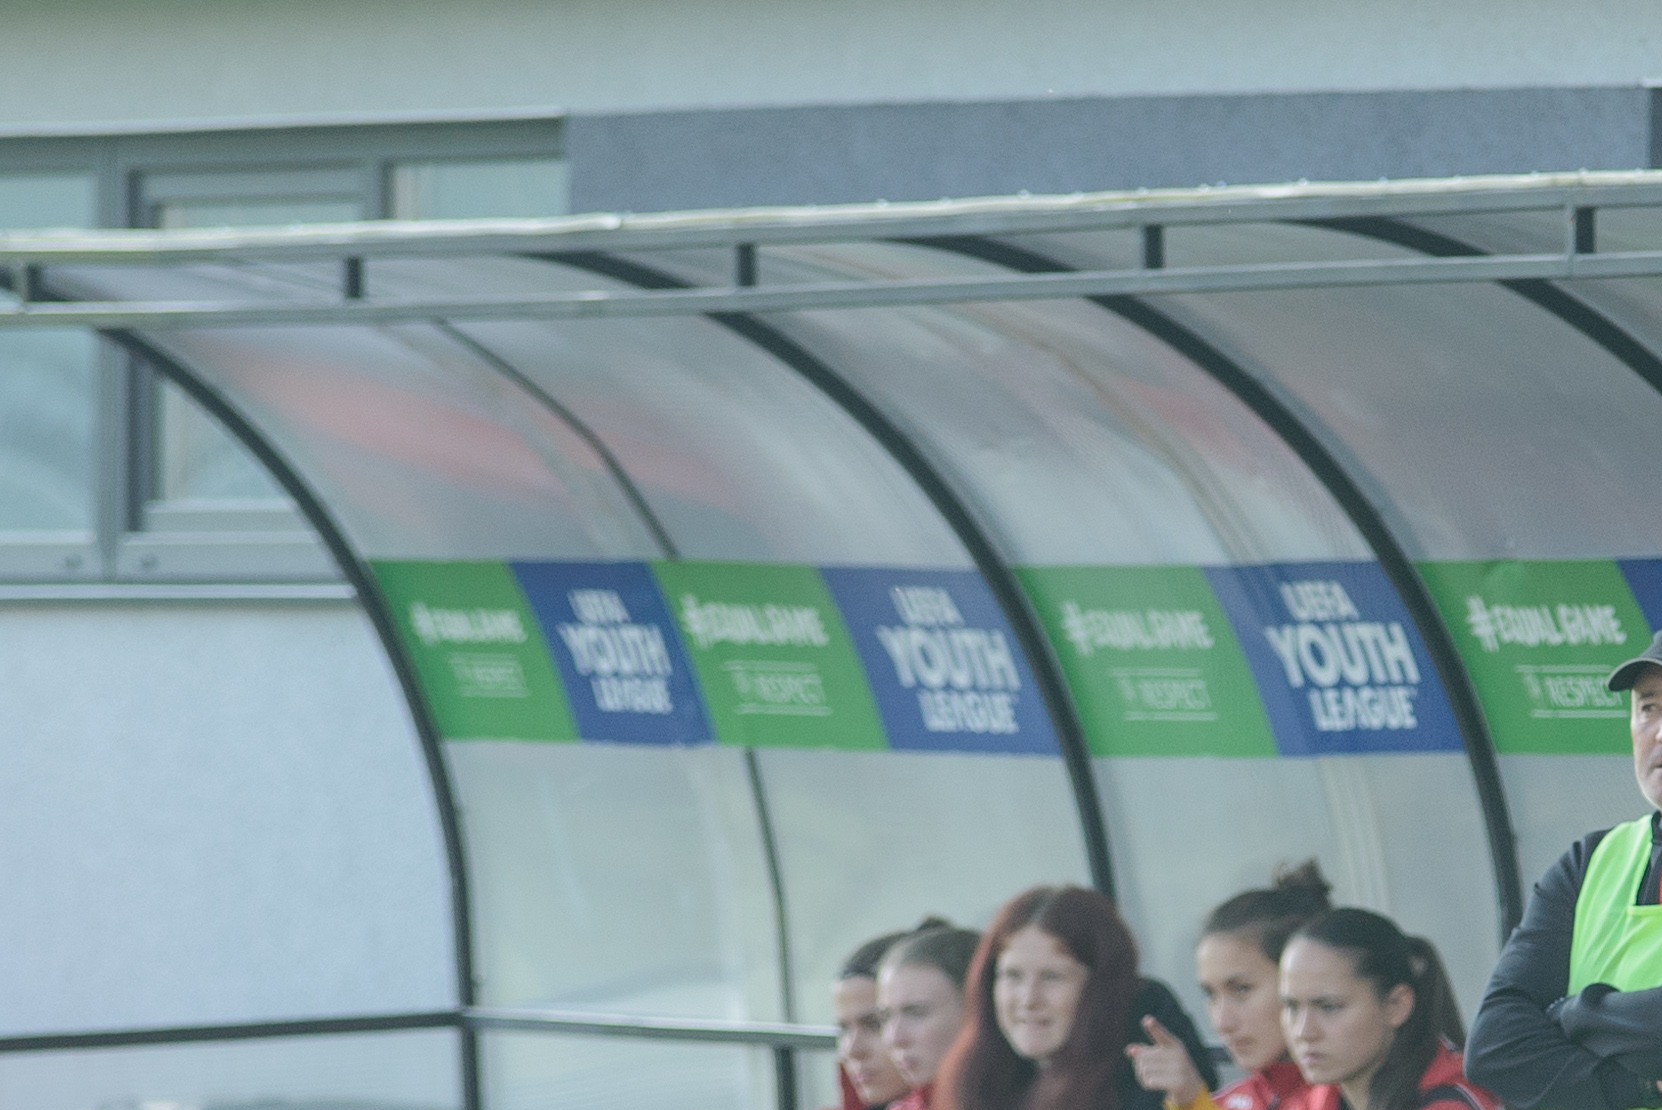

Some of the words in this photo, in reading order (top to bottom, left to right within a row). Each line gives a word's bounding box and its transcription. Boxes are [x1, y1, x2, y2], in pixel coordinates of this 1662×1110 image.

[1280, 580, 1361, 622] UEFA
[876, 624, 1021, 692] YOUTH
[1265, 622, 1421, 689] YOUTH
[1308, 688, 1418, 732] LEAGUE
